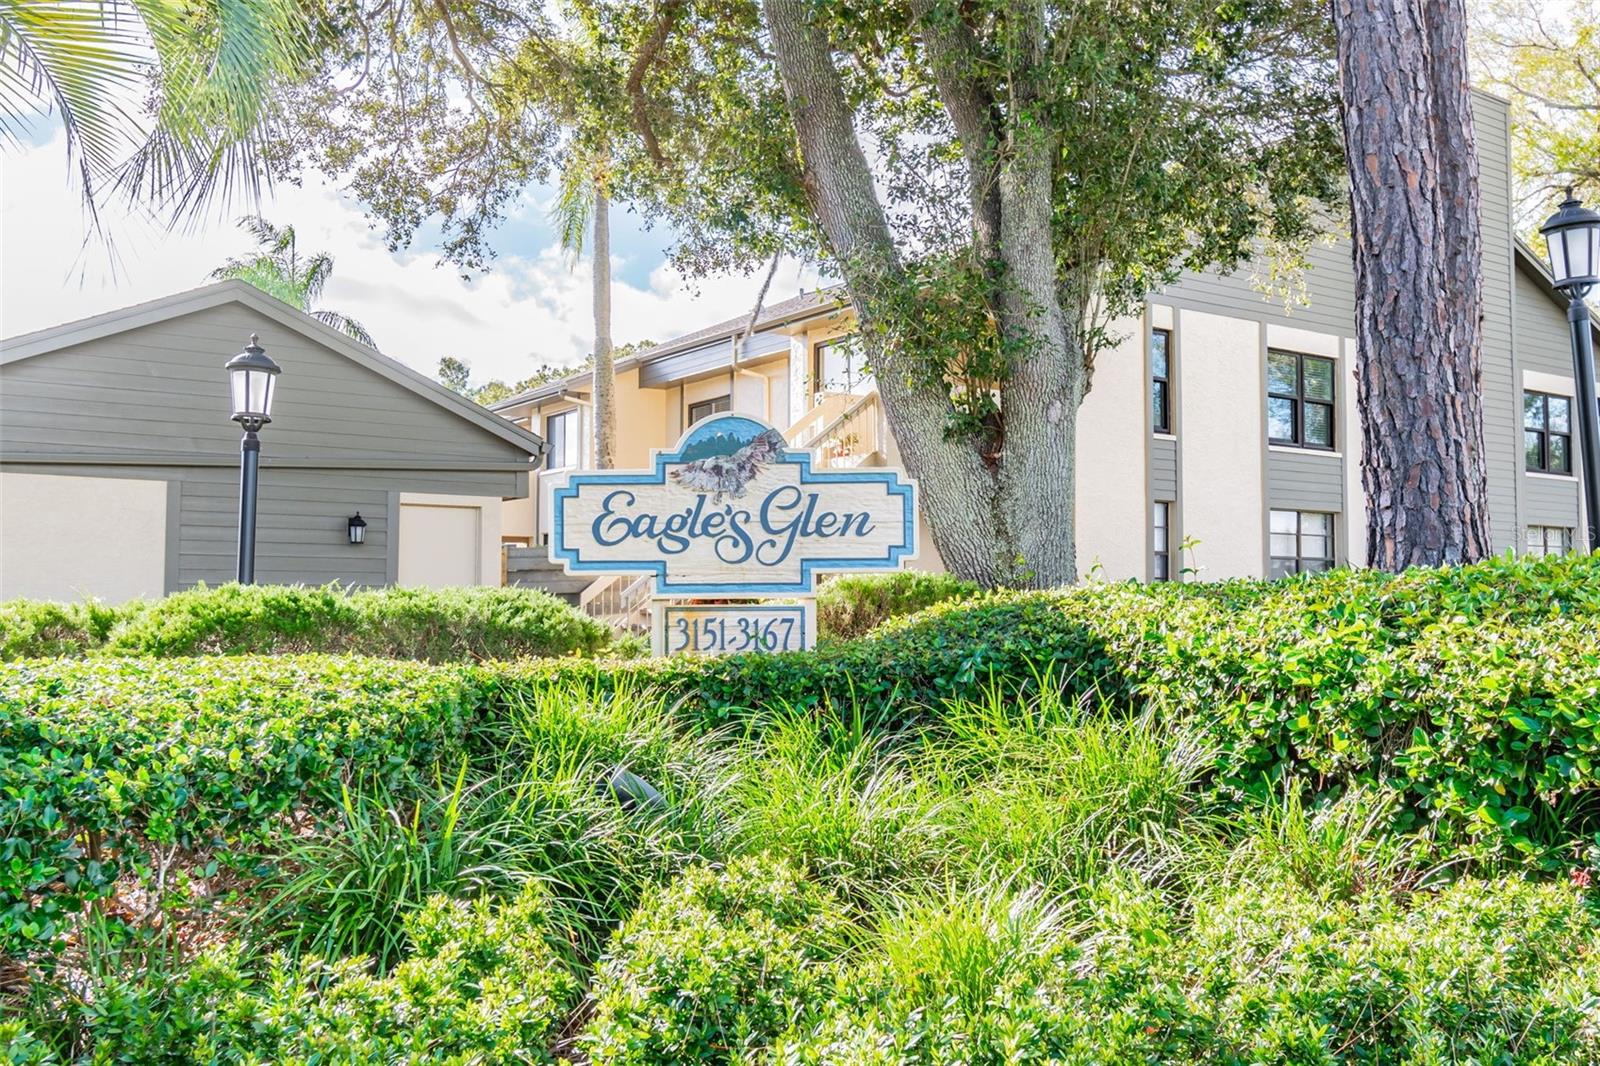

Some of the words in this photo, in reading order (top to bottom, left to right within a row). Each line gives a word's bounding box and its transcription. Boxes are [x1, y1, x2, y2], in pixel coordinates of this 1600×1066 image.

[592, 491, 754, 564] Eagle's
[756, 486, 875, 566] Glen
[675, 617, 795, 651] 3151-3167
